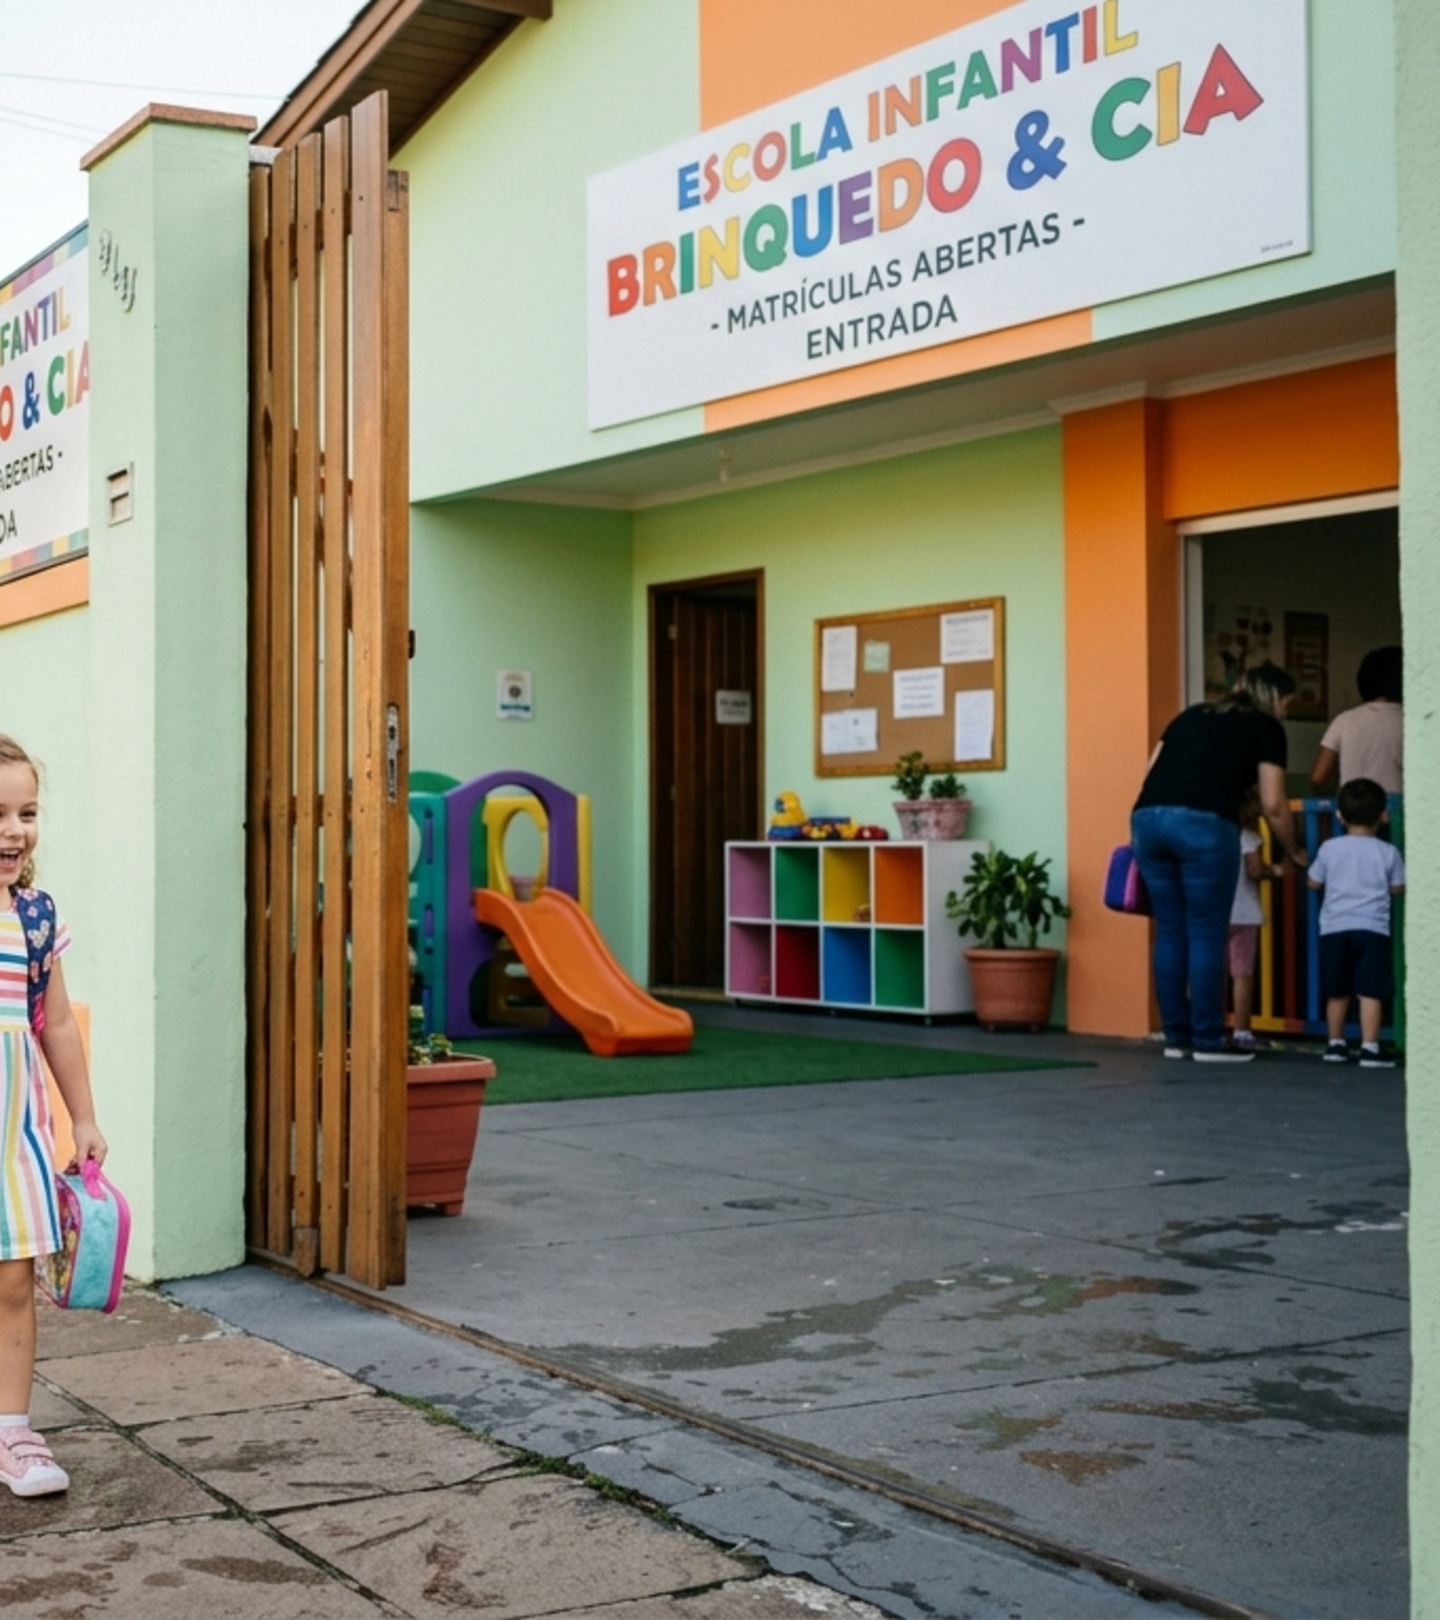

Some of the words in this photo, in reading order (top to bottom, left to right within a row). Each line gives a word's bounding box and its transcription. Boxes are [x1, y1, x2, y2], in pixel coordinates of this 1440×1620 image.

[677, 106, 853, 211] ESCOLA
[867, 0, 1138, 142] INFANTIL
[607, 137, 982, 317] BRINQUEDO
[1006, 109, 1067, 190] &
[1091, 43, 1264, 161] CIA
[727, 259, 903, 334] MATRÍCULAS
[912, 213, 1061, 282] ABERTAS
[806, 294, 958, 359] ENTRADA
[22, 371, 40, 430] &
[47, 340, 89, 416] CIA
